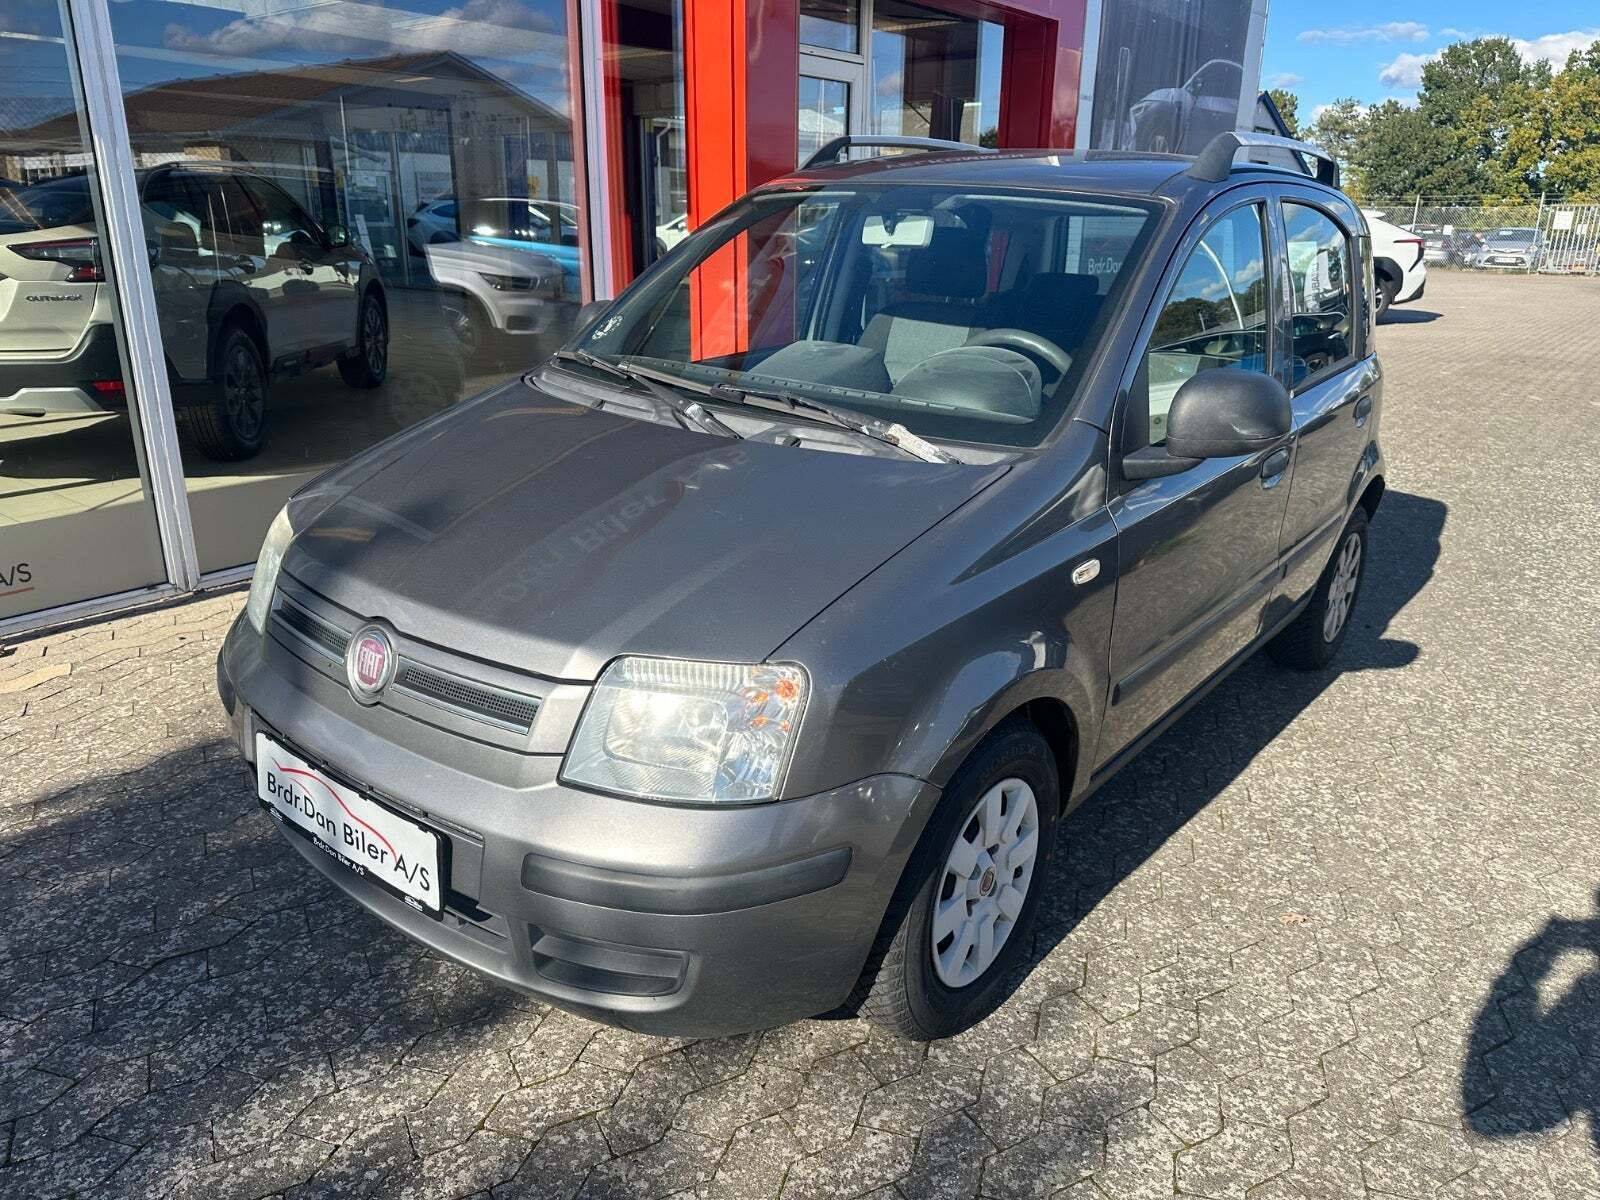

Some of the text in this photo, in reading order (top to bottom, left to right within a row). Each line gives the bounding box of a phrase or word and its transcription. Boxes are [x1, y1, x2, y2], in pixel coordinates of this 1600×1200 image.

[360, 646, 383, 679] FIAT
[267, 771, 430, 892] Brdr.Dan Biler A/S
